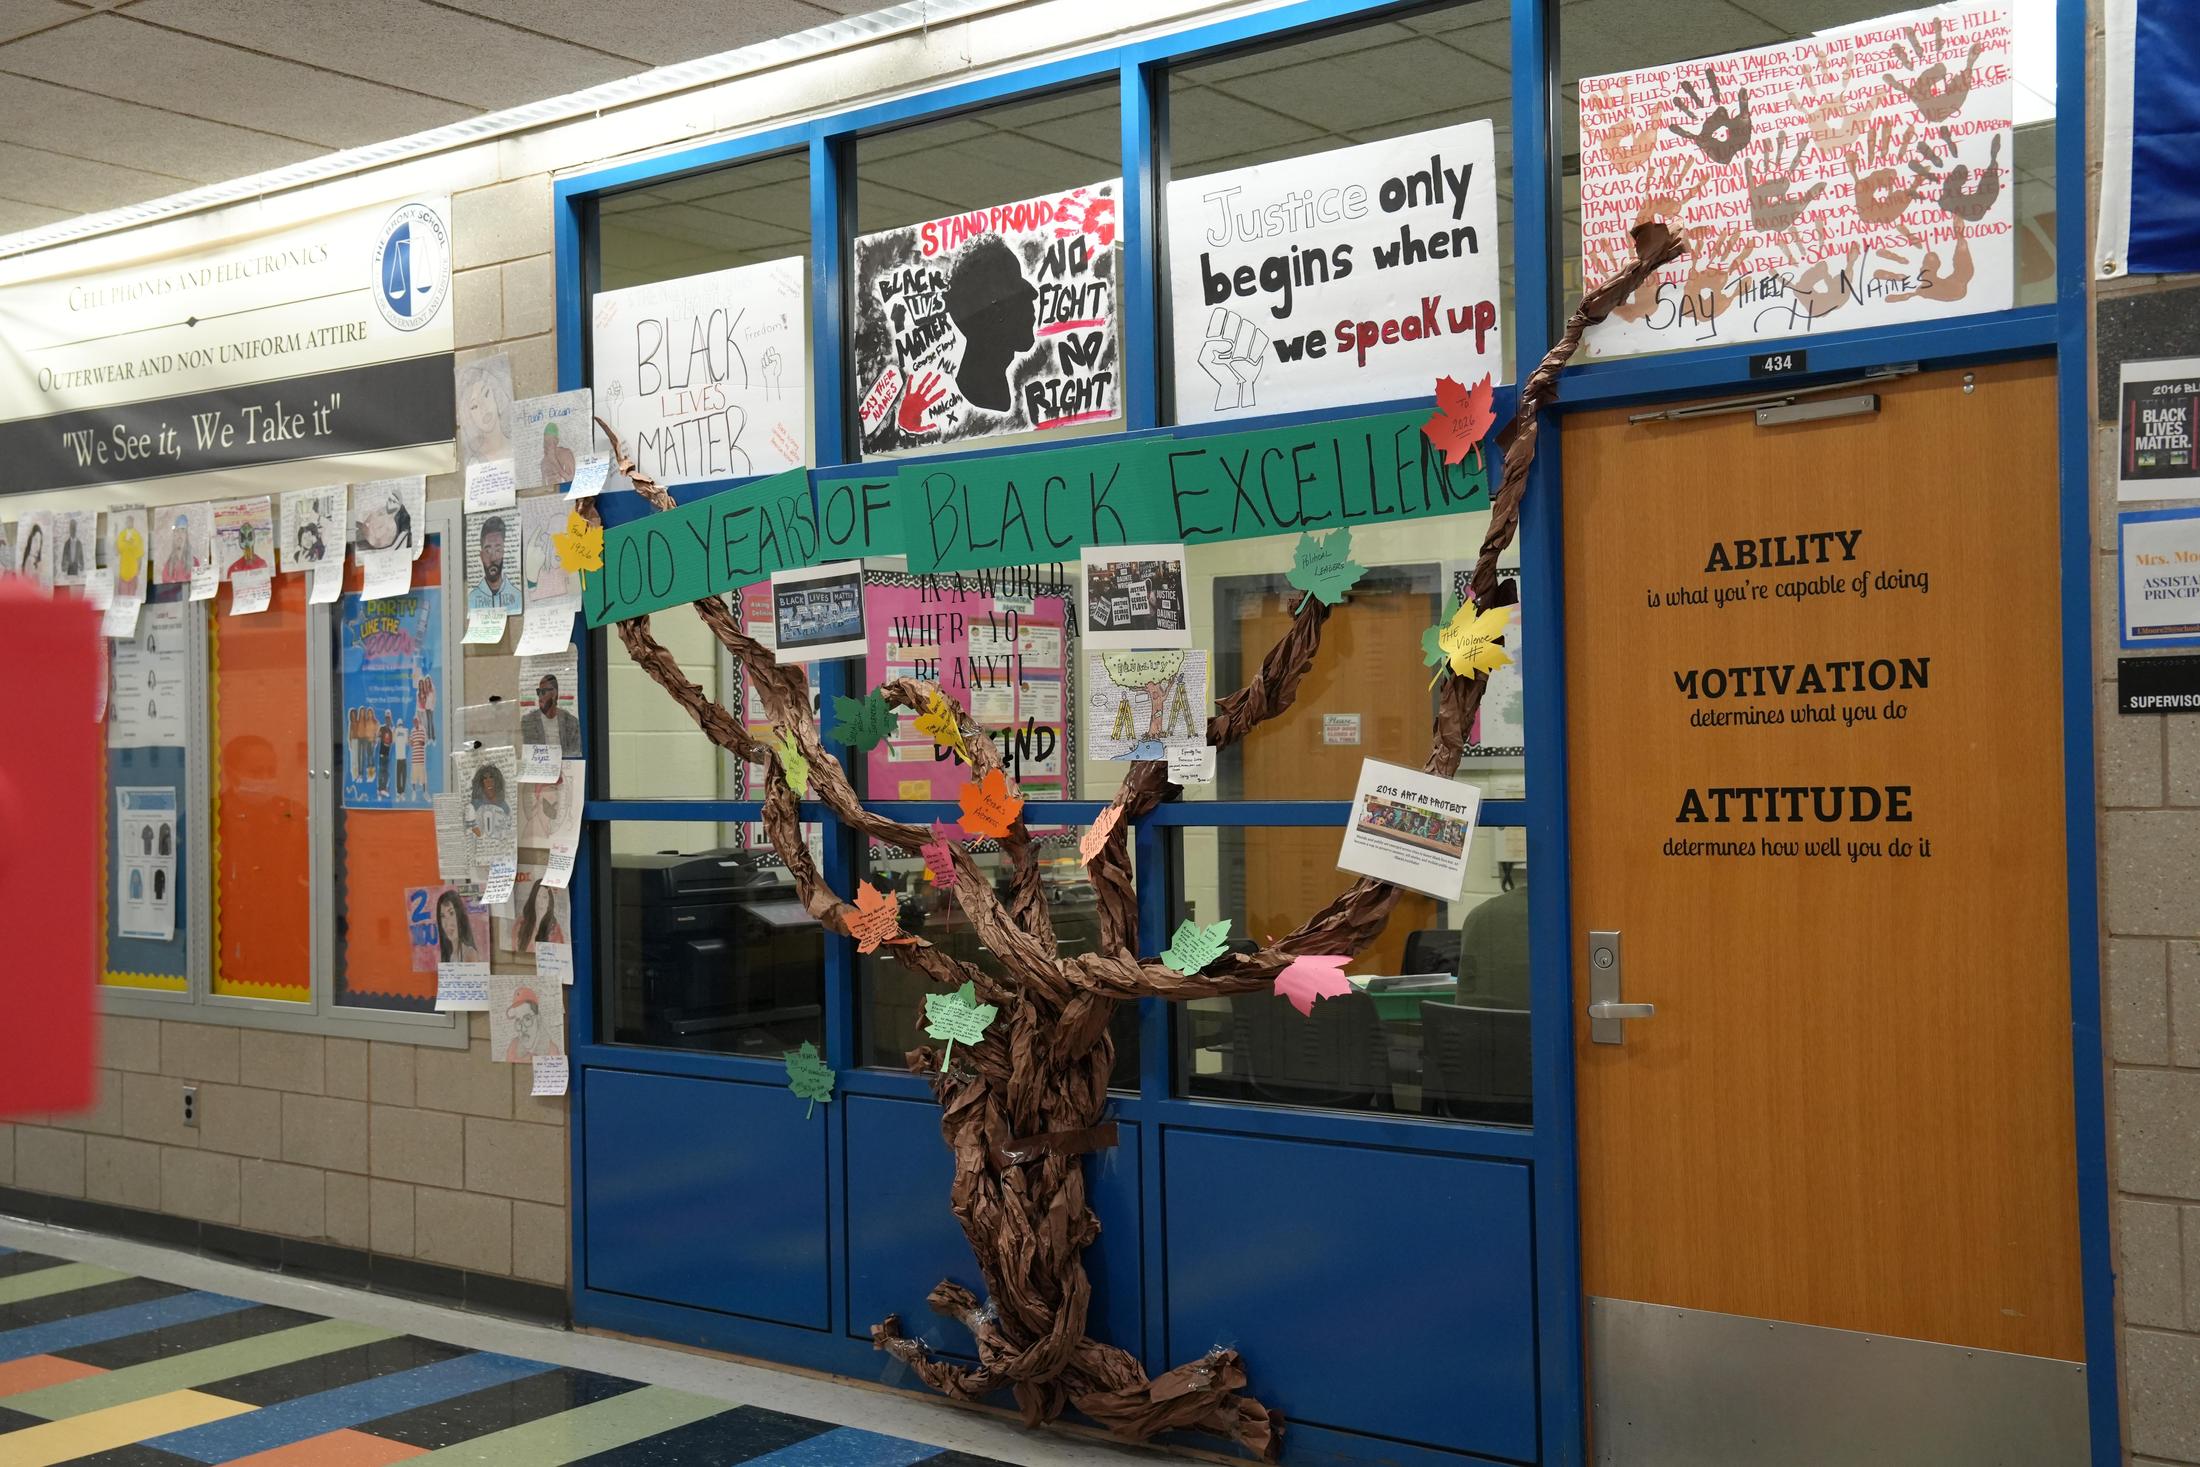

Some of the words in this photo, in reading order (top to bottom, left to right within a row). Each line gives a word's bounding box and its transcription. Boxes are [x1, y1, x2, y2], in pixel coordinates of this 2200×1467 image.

[1631, 87, 1670, 103] ELLIS
[1971, 26, 2008, 43] CLARK
[1636, 71, 1670, 89] FLOYD
[1742, 50, 1789, 72] TAYLOR
[1962, 10, 2000, 27] HILL
[1203, 185, 1368, 248] Justice
[1379, 154, 1473, 220] only
[1582, 179, 1633, 201] OSCAR
[418, 211, 446, 248] SCHOOL
[920, 210, 989, 257] STAND
[990, 200, 1054, 233] PROUD
[1583, 220, 1628, 236] COREY
[1687, 199, 1755, 223] NATASHA
[112, 271, 172, 306] PHONES
[176, 269, 212, 292] AND
[217, 244, 328, 283] ELECTRONICS
[1038, 235, 1089, 281] NO
[1200, 243, 1353, 319] begins
[1372, 224, 1479, 270] when
[1756, 256, 1799, 271] BELL
[878, 267, 953, 303] BLACK
[1646, 282, 1716, 341] SAY
[1724, 271, 1812, 308] THEIR
[1840, 244, 1934, 305] NAMES
[907, 293, 946, 320] LIVES
[1038, 282, 1107, 325] FIGHT
[895, 315, 953, 369] MATTER
[1273, 330, 1327, 363] we
[1447, 300, 1498, 355] up.
[38, 361, 135, 393] OUTERWEAR
[138, 355, 173, 379] AND
[177, 349, 214, 370] NON
[219, 333, 302, 364] UNIFORM
[306, 321, 367, 348] ATTIRE
[637, 307, 748, 397] BLACK
[912, 351, 936, 372] George
[936, 334, 957, 355] Floyd
[937, 357, 956, 375] MLK
[1057, 331, 1103, 377] NO
[1764, 355, 1792, 372] 434
[661, 383, 726, 418] LIVES
[873, 382, 897, 421] NAMES
[1025, 372, 1112, 424] RIGHT
[2152, 384, 2182, 395] 2016
[859, 396, 878, 420] SAY
[946, 411, 959, 427] X
[1452, 415, 1475, 433] 2026
[2143, 408, 2187, 423] BLACK
[62, 430, 109, 468] "We
[113, 423, 151, 462] See
[158, 423, 183, 461] it,
[192, 411, 235, 451] We
[241, 400, 305, 445] Take
[313, 393, 341, 436] it"
[638, 405, 753, 477] MATTER
[2136, 435, 2192, 450] MATTER.
[2146, 422, 2183, 436] LIVES
[571, 542, 592, 559] 1926
[595, 528, 675, 622] 100
[685, 489, 820, 593] YEARS
[824, 481, 892, 548] OF
[920, 461, 1127, 570] BLACK
[1704, 529, 1862, 573] ABILITY
[1315, 563, 1344, 576] LEADERS
[2136, 554, 2169, 566] Mrs.
[779, 596, 805, 606] BLACK
[810, 593, 829, 602] LIVES
[920, 573, 941, 603] IN
[952, 571, 966, 603] A
[977, 562, 1064, 600] WORLD
[1156, 590, 1176, 599] JUSTICE
[1647, 589, 1660, 608] is
[1666, 585, 1709, 607] what
[1714, 578, 1768, 609] you're
[1775, 574, 1846, 602] capable
[1851, 570, 1870, 598] of
[1874, 569, 1929, 594] doing
[367, 600, 417, 617] PARTY
[1132, 603, 1147, 611] FLOYD
[1157, 609, 1176, 620] DAUNTE
[360, 620, 379, 638] LIKE
[381, 618, 399, 635] THE
[1442, 626, 1460, 643] THE
[1457, 635, 1492, 649] Violence
[1673, 657, 1930, 700] MOTIVATION
[1690, 705, 1784, 727] determines
[1790, 703, 1836, 724] what
[1842, 703, 1877, 728] you
[1883, 700, 1908, 720] do
[1376, 785, 1398, 796] 2015
[1401, 790, 1417, 801] ART
[1418, 794, 1428, 804] AS
[1429, 797, 1467, 815] PROTEST
[1676, 785, 1913, 823] ATTITUDE
[1663, 837, 1756, 857] determines
[1761, 837, 1799, 857] how
[1804, 837, 1841, 857] well
[1847, 838, 1882, 863] you
[1888, 837, 1913, 857] do
[1919, 837, 1931, 857] it
[410, 889, 432, 922] 2
